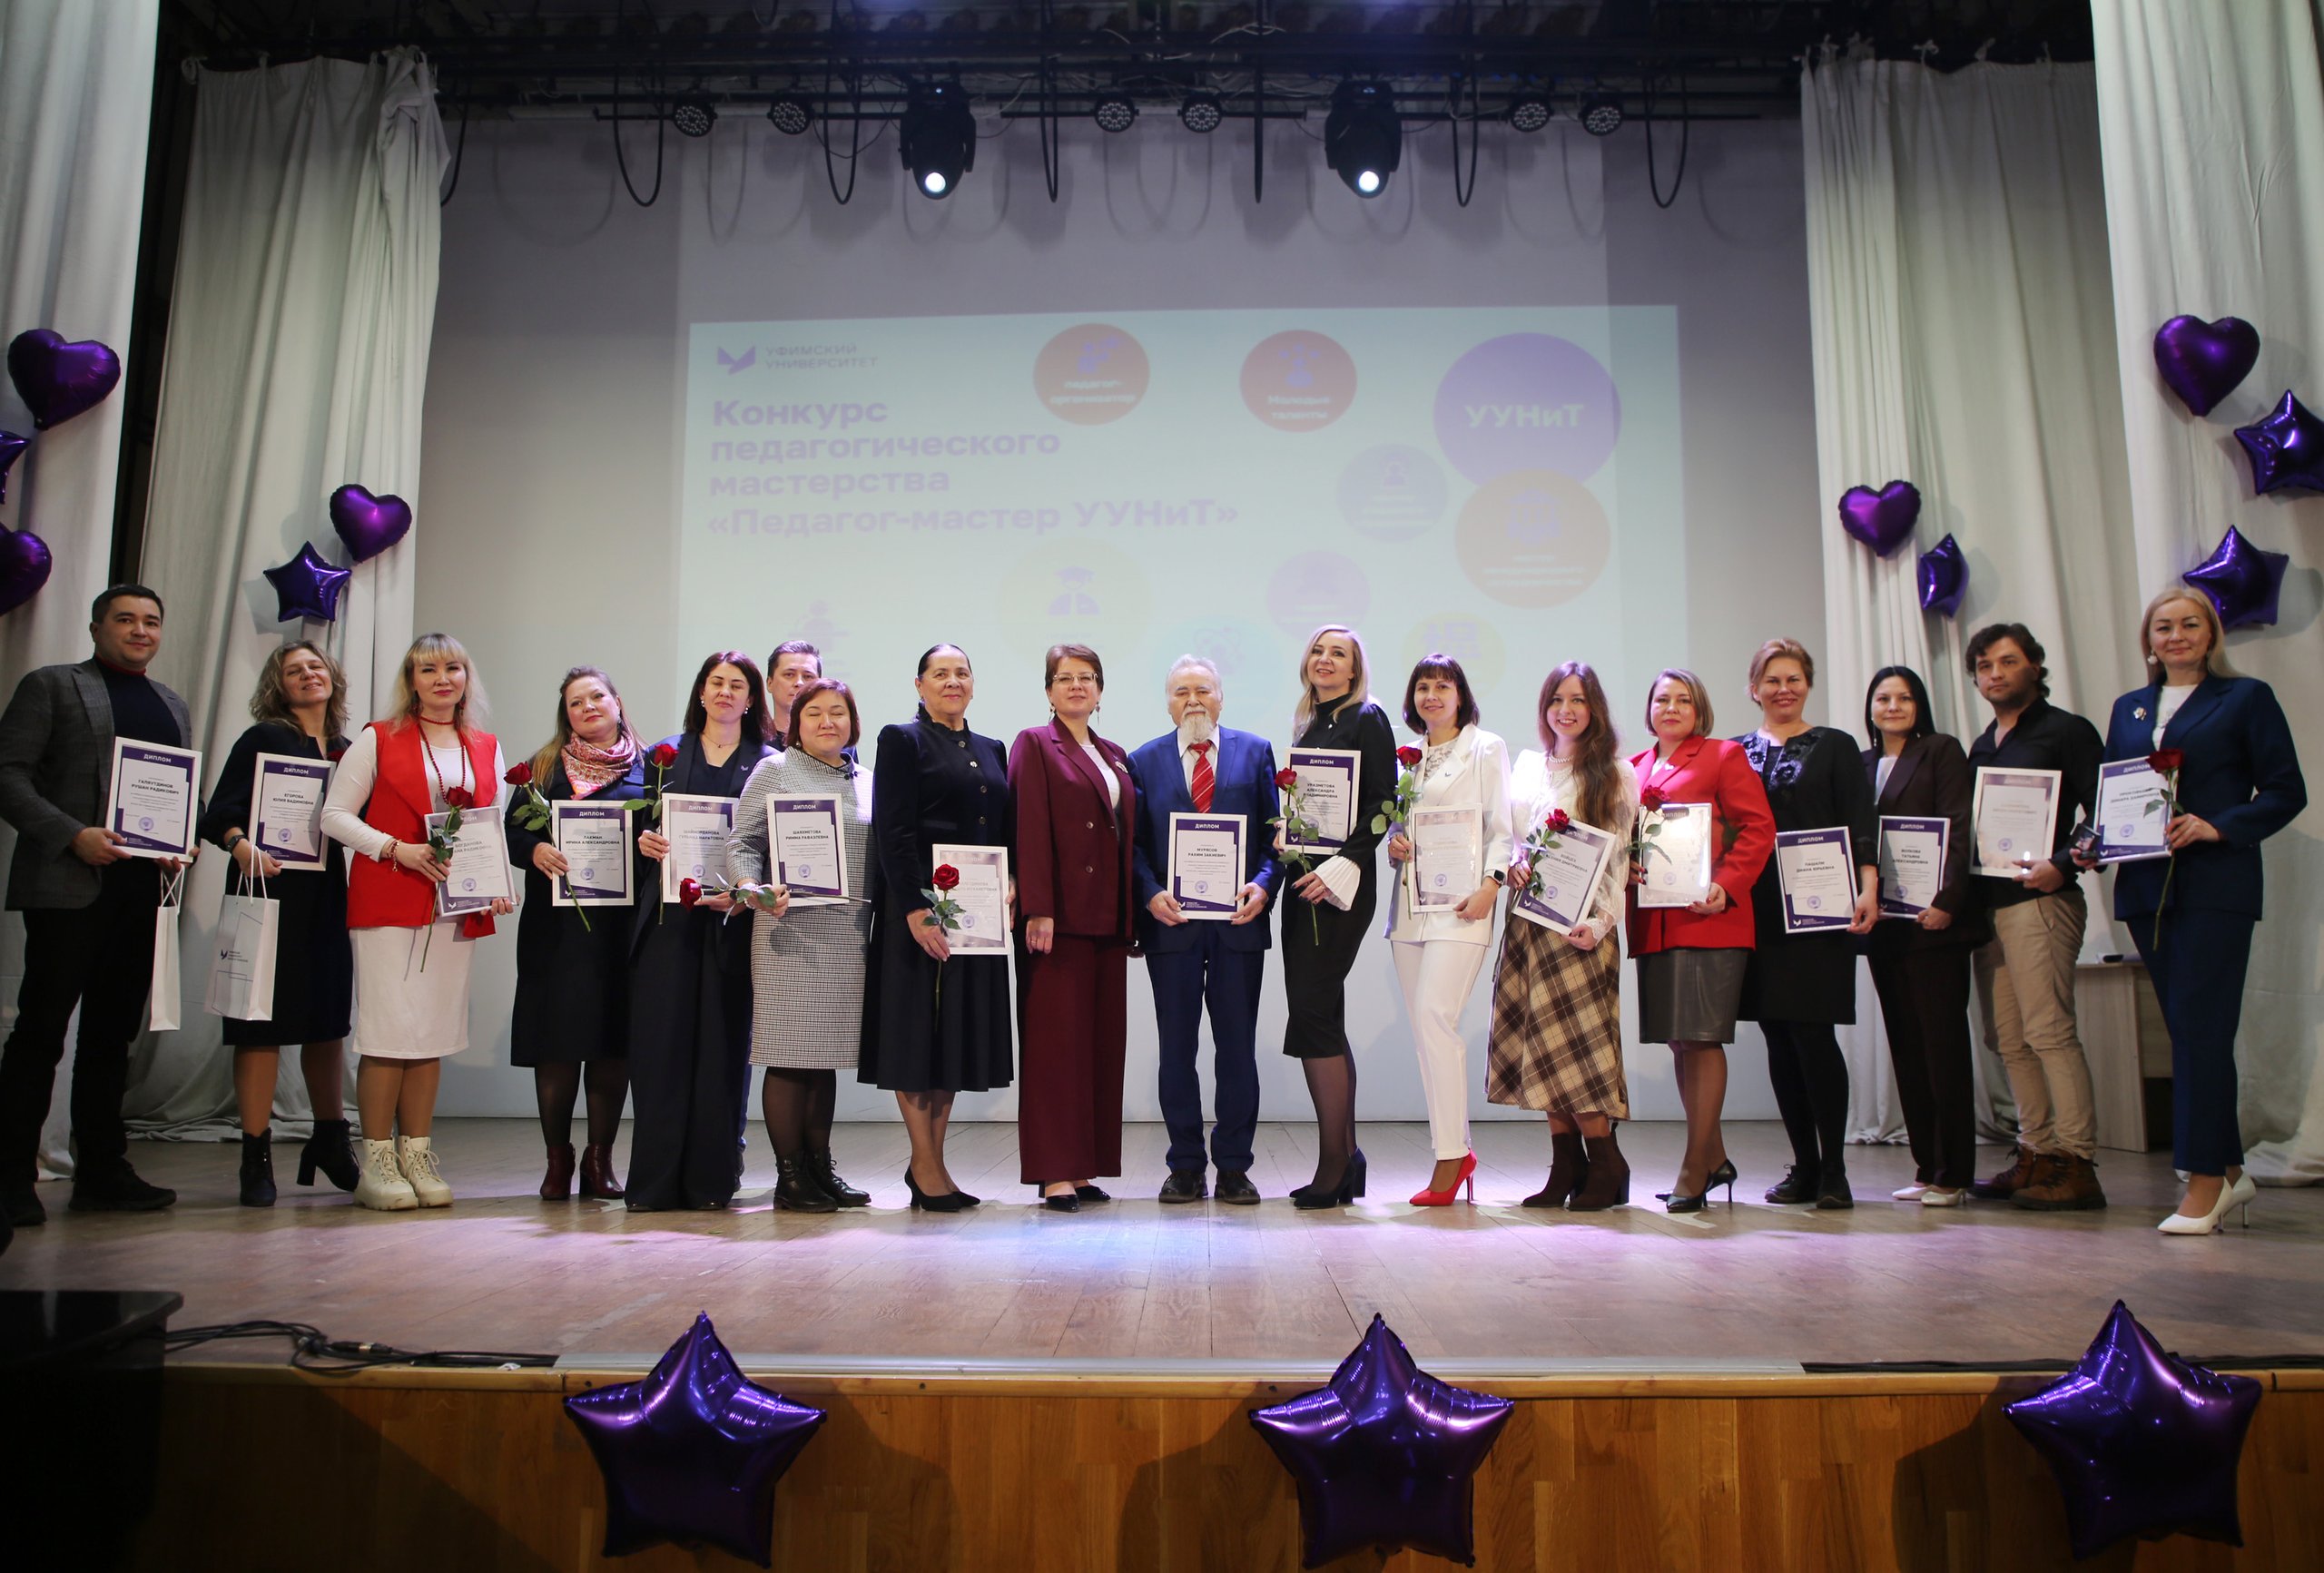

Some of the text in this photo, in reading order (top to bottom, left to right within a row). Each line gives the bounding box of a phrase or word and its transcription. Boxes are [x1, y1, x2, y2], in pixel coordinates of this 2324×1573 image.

[765, 342, 858, 357] УФИМСКИЙ
[765, 356, 878, 371] УНИВЕРСИТЕТ
[713, 399, 889, 430] Конкурс
[1463, 404, 1586, 429] УУНиТ
[711, 433, 1060, 465] педагогического
[710, 471, 950, 500] мастерства
[707, 498, 1239, 538] «Педагог-мастер УУНиТ»
[143, 754, 172, 763] ДИПЛОМ
[283, 767, 309, 775] ДИПЛОМ
[2123, 764, 2151, 773] ДИПЛОМ
[1797, 836, 1824, 844] ДИПЛОМ
